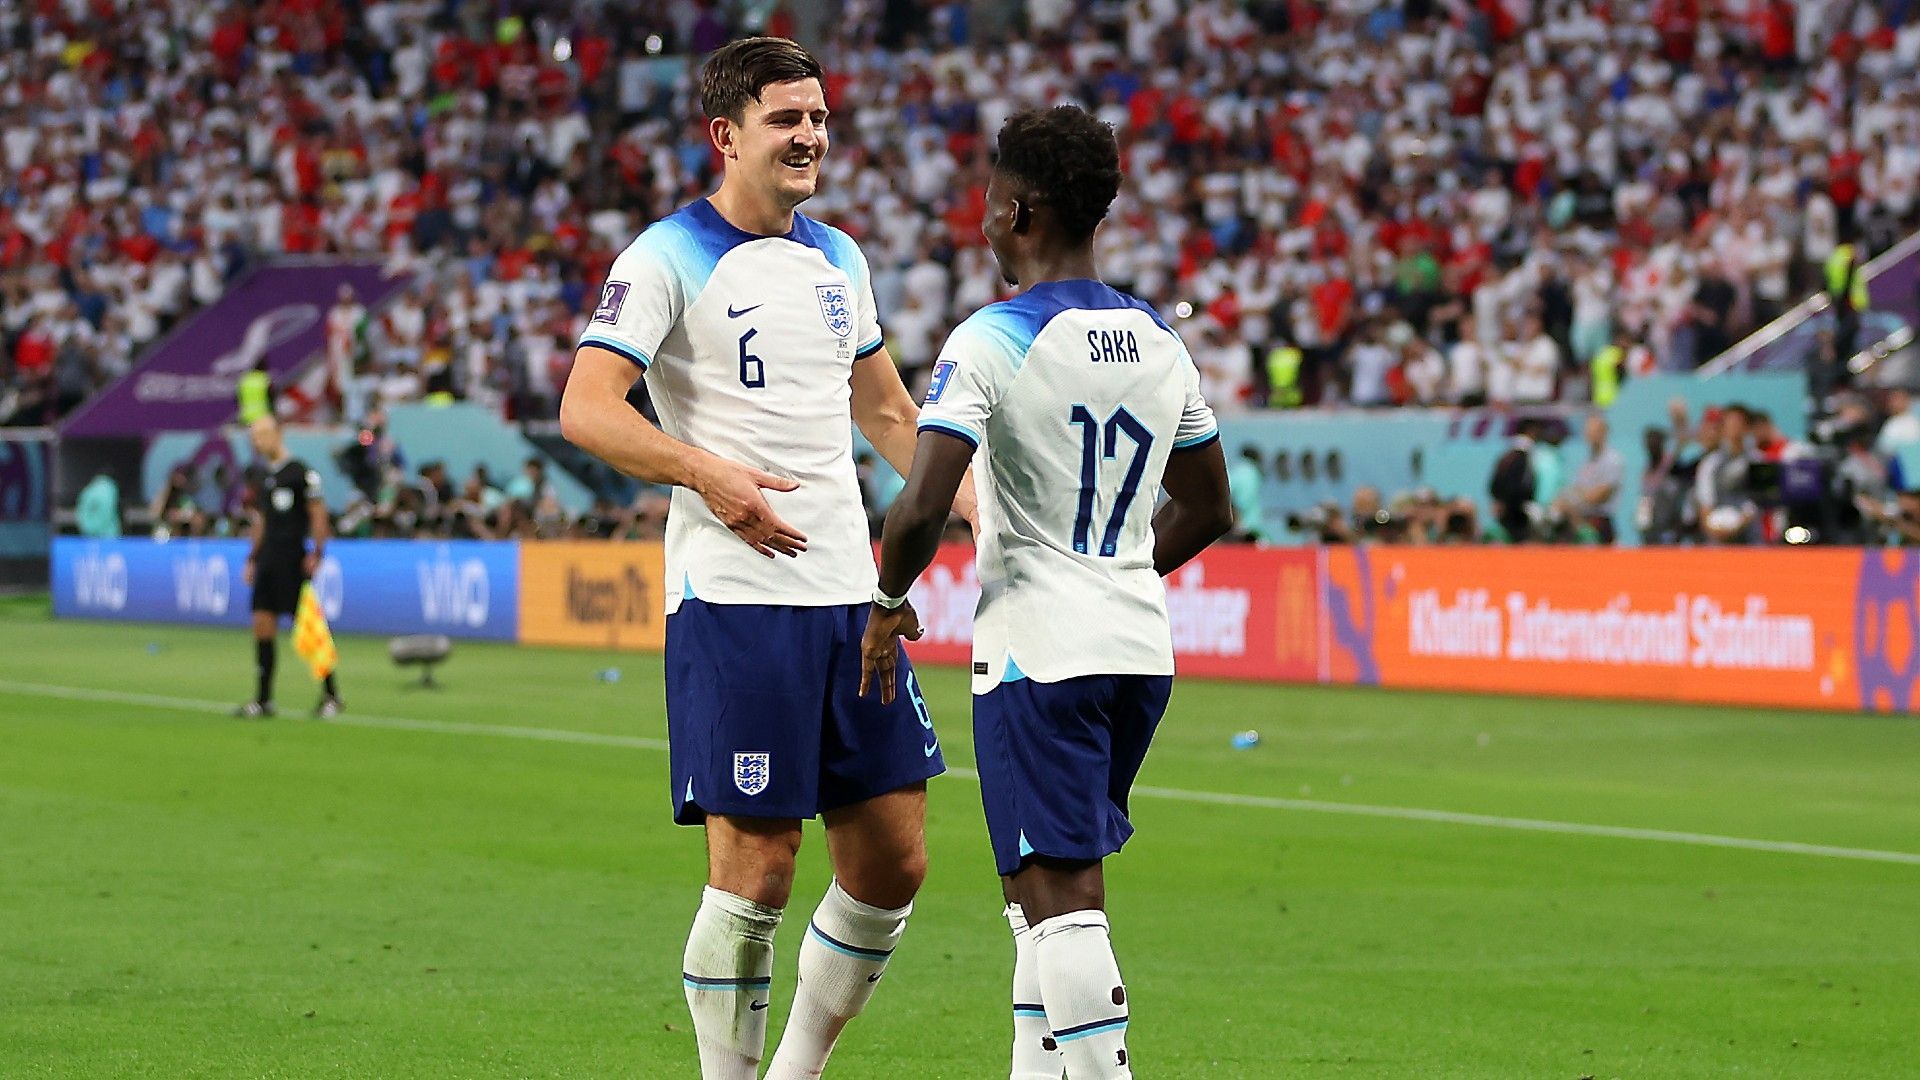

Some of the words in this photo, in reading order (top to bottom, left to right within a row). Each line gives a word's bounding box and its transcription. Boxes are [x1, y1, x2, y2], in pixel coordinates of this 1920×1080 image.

[739, 326, 766, 390] 6
[1087, 329, 1141, 364] SAKA
[1069, 403, 1156, 558] 17
[1409, 587, 1502, 658] Khalifa
[1506, 591, 1688, 667] International
[1691, 594, 1815, 672] Stadium
[906, 670, 932, 730] 6
